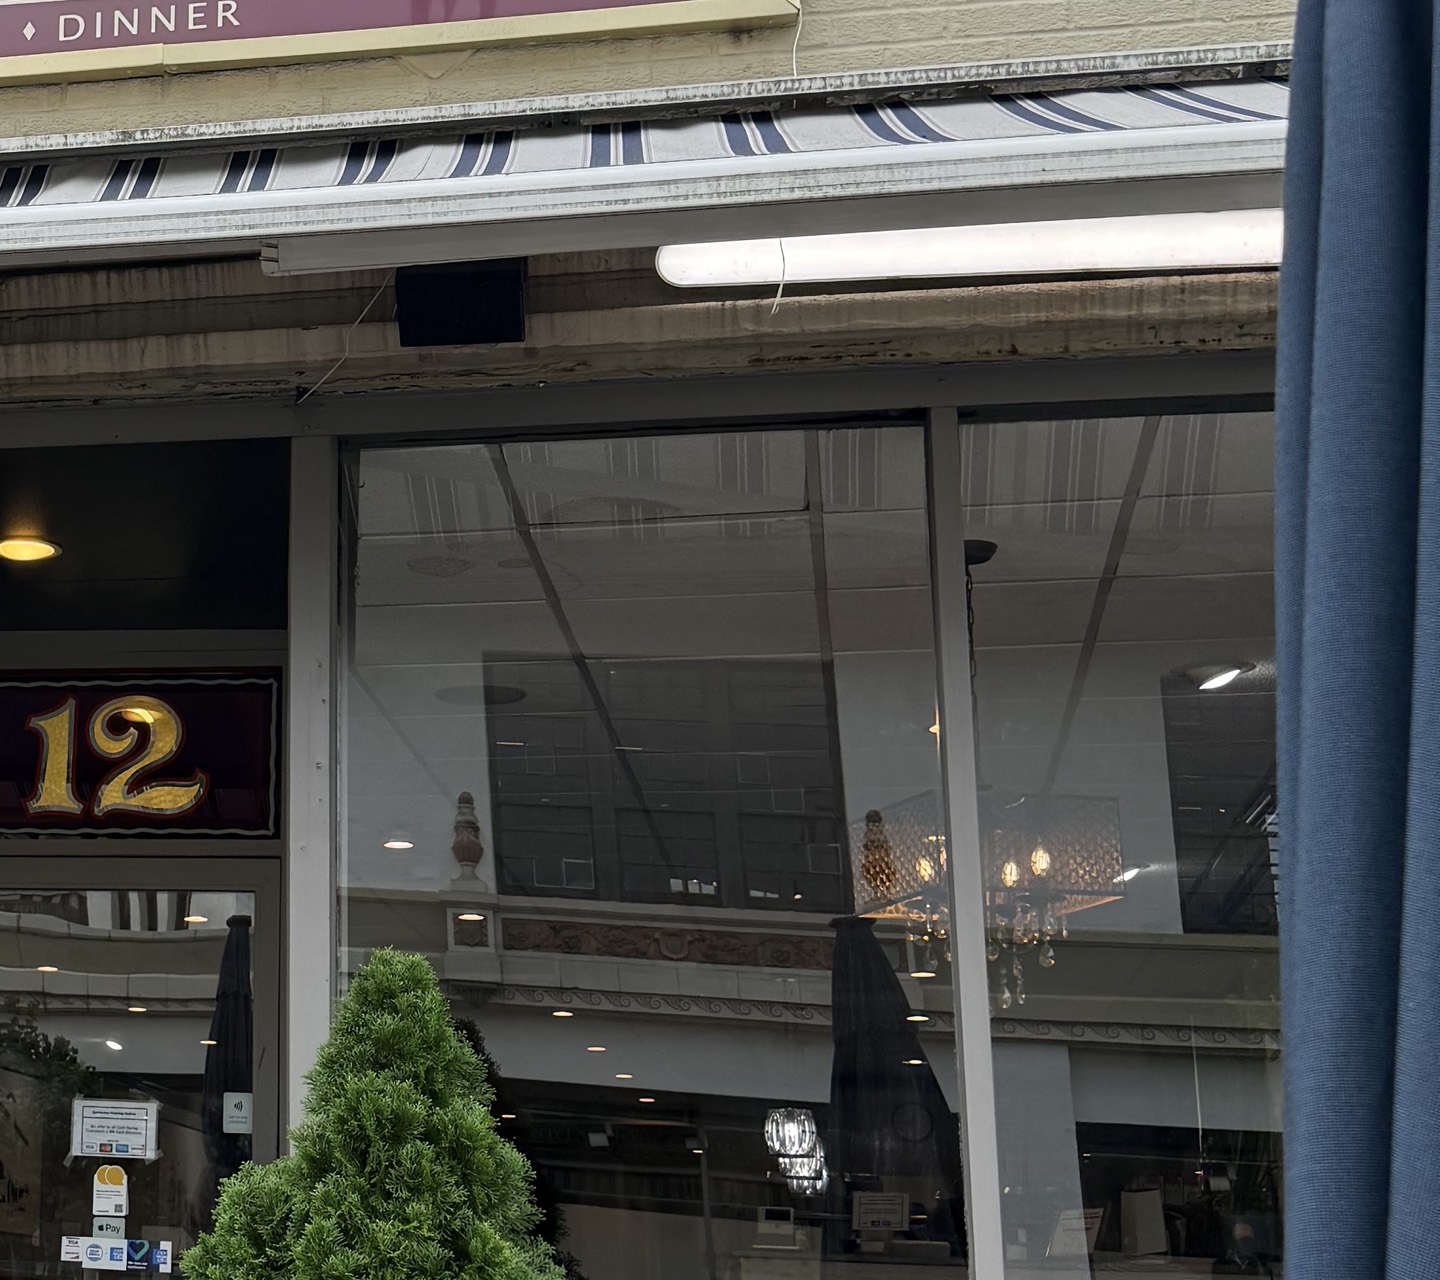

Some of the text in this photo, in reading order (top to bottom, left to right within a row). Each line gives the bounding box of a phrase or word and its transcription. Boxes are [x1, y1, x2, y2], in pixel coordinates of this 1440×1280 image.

[58, 0, 242, 44] DINNER
[26, 694, 208, 817] 12
[105, 1223, 121, 1234] Pay
